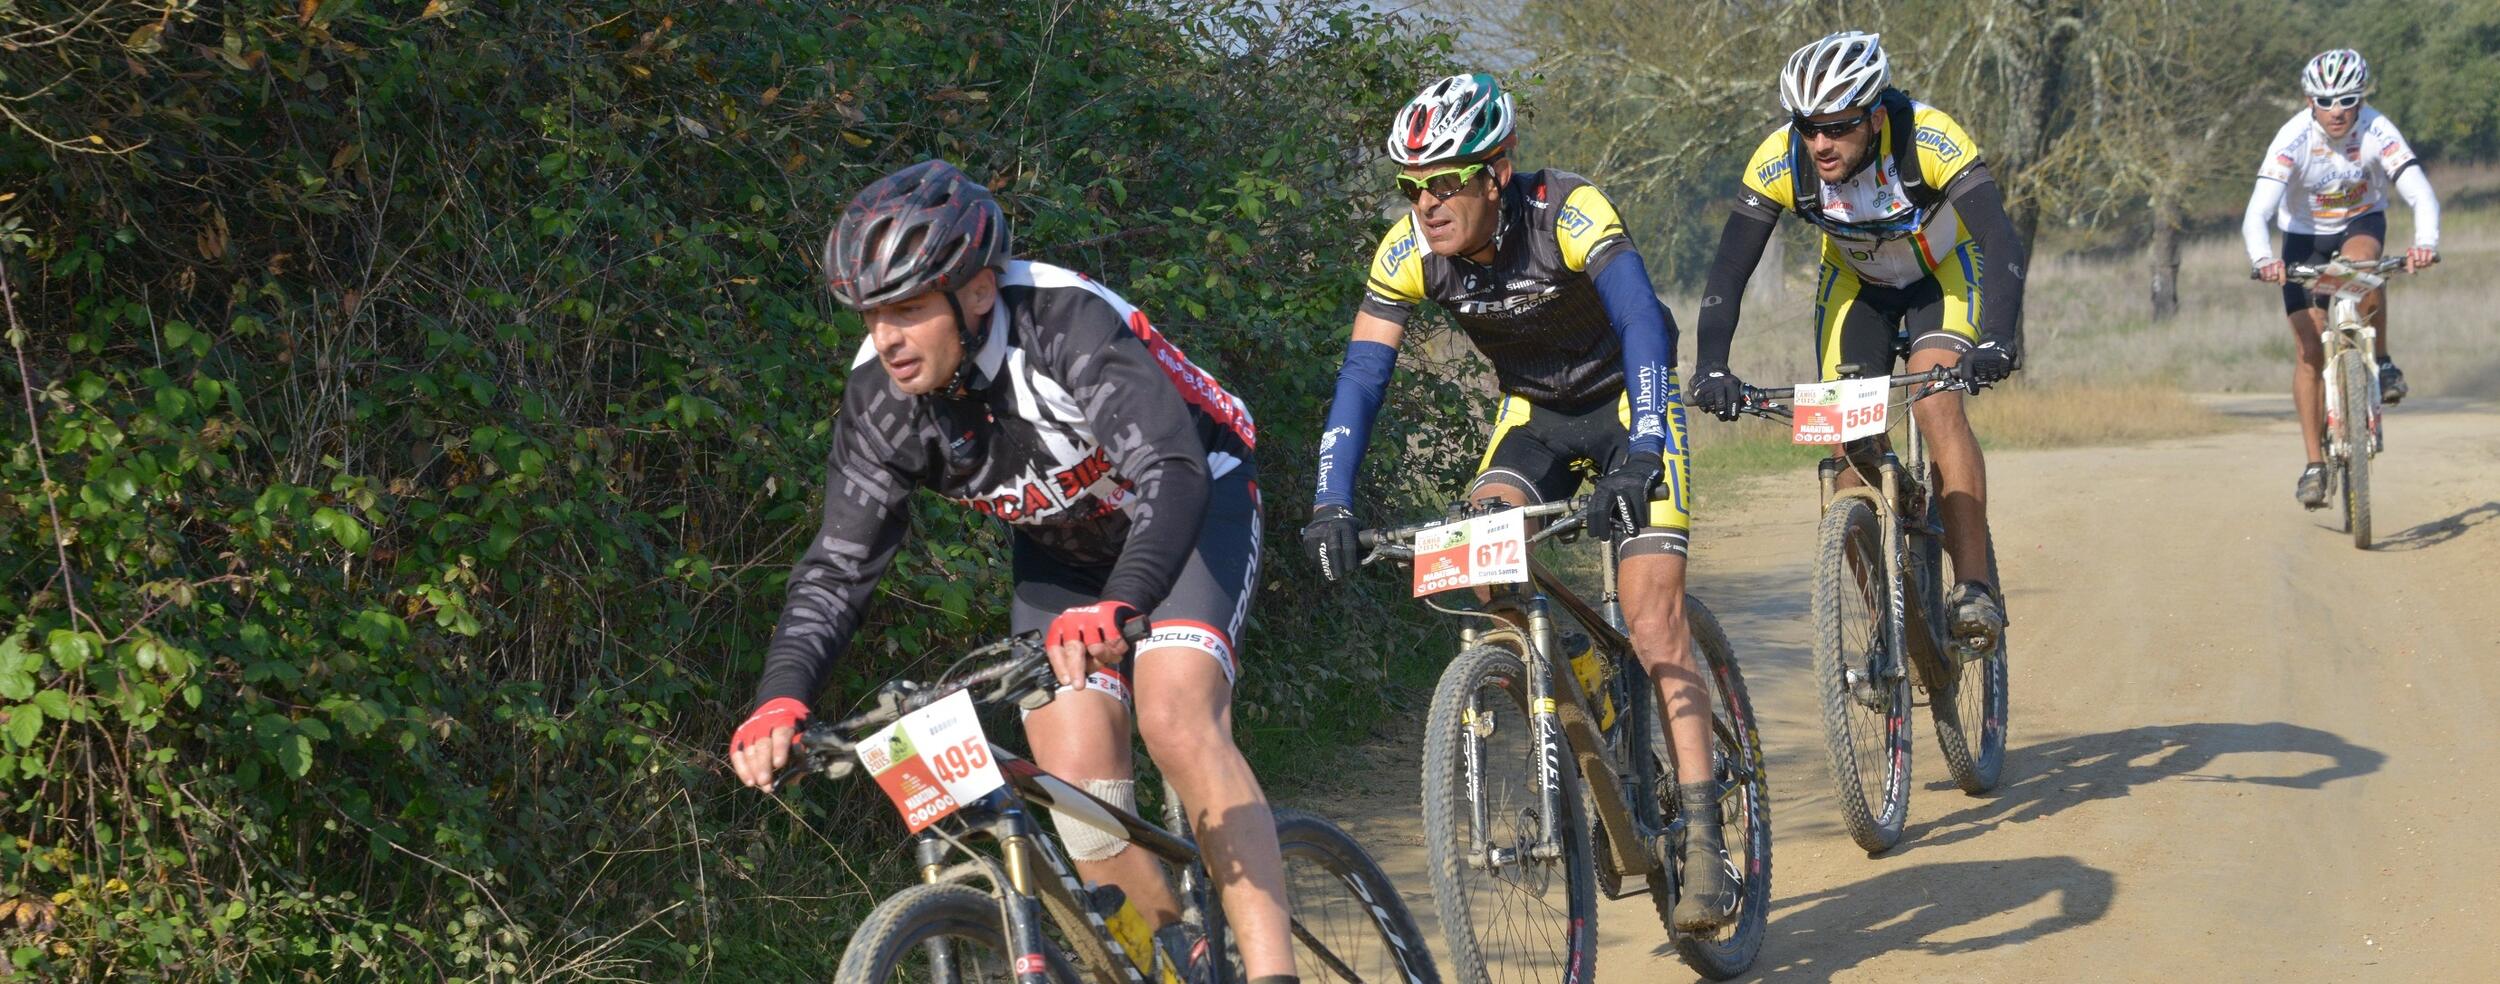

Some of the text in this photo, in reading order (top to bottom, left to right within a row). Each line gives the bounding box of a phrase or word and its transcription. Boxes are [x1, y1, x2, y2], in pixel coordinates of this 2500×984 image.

[1636, 360, 1658, 412] Liberty
[1846, 403, 1885, 429] 558
[1476, 539, 1520, 569] 672
[1145, 632, 1202, 643] FOCUS
[932, 735, 988, 784] 495
